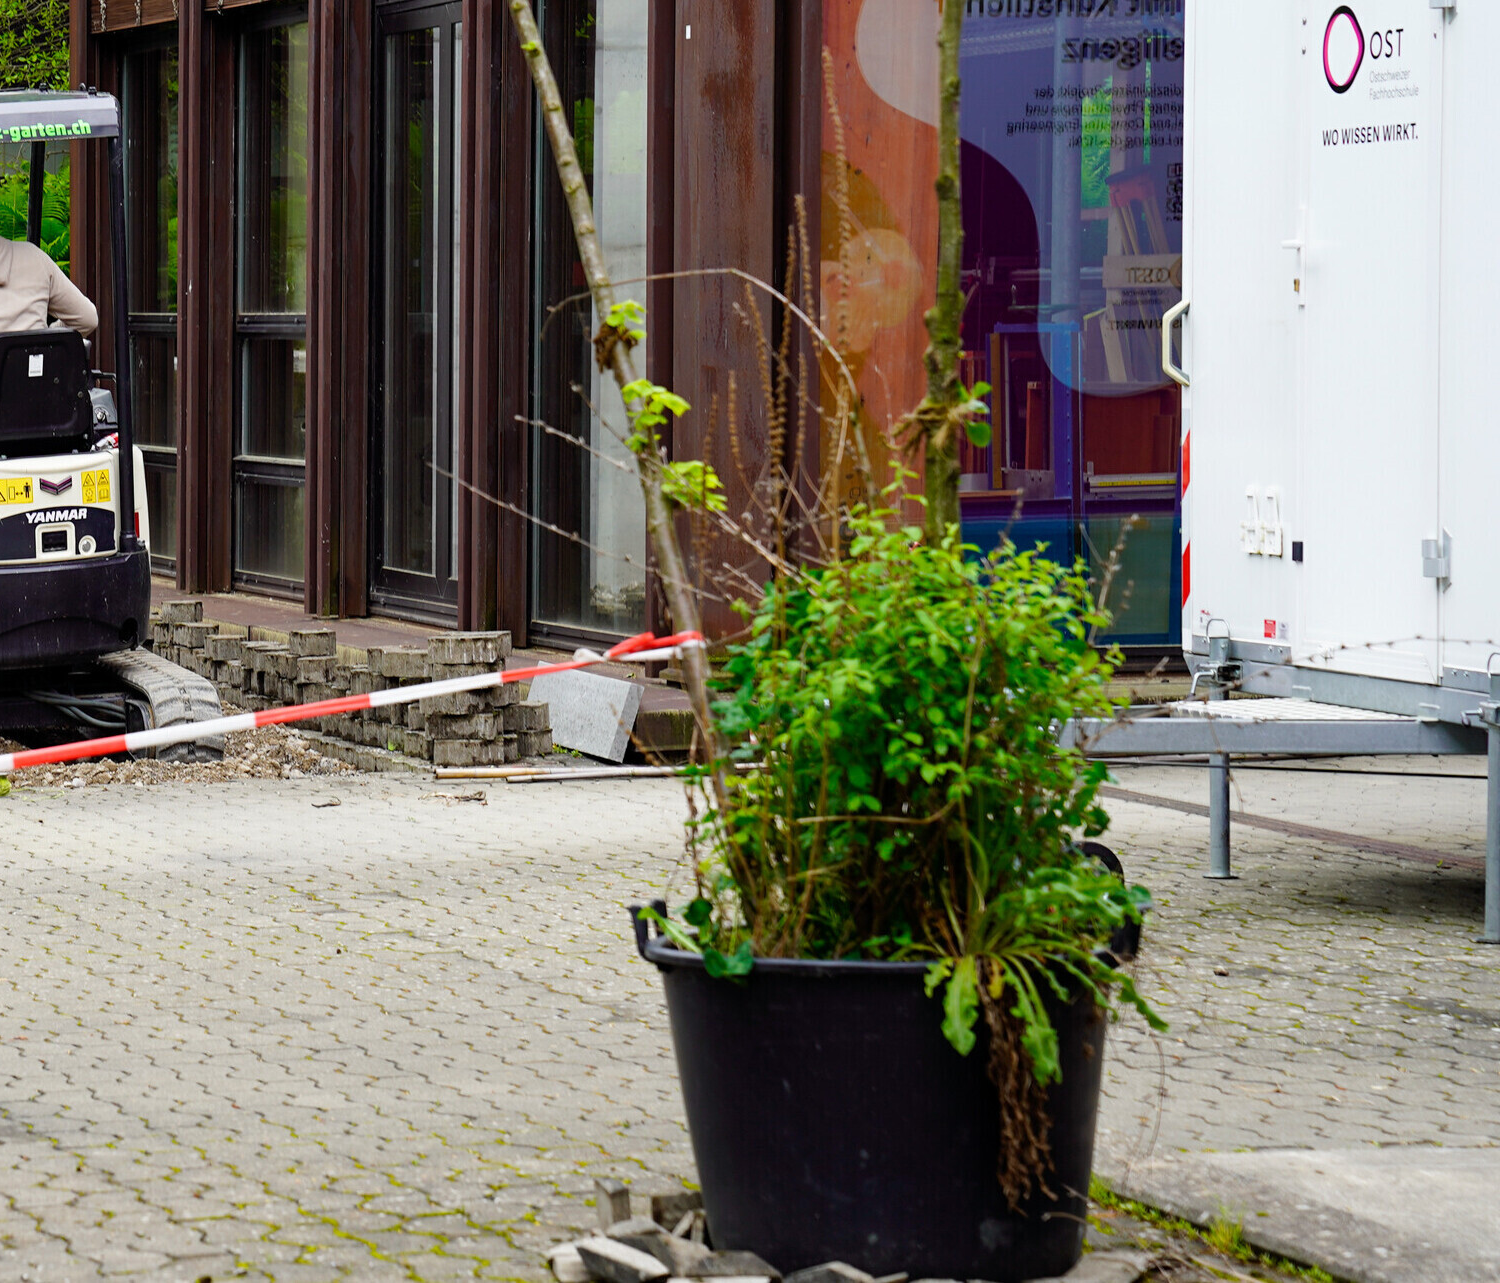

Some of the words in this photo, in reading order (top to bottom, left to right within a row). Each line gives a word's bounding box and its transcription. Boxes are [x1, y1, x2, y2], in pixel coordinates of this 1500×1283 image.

[1369, 29, 1404, 59] OST
[1369, 69, 1411, 84] Ostschweizer
[1369, 84, 1419, 100] Fachhochschule
[1322, 130, 1339, 146] WO
[1341, 126, 1380, 145] WISSEN
[1382, 122, 1419, 142] WIRKT.
[25, 508, 88, 524] YANMAR
